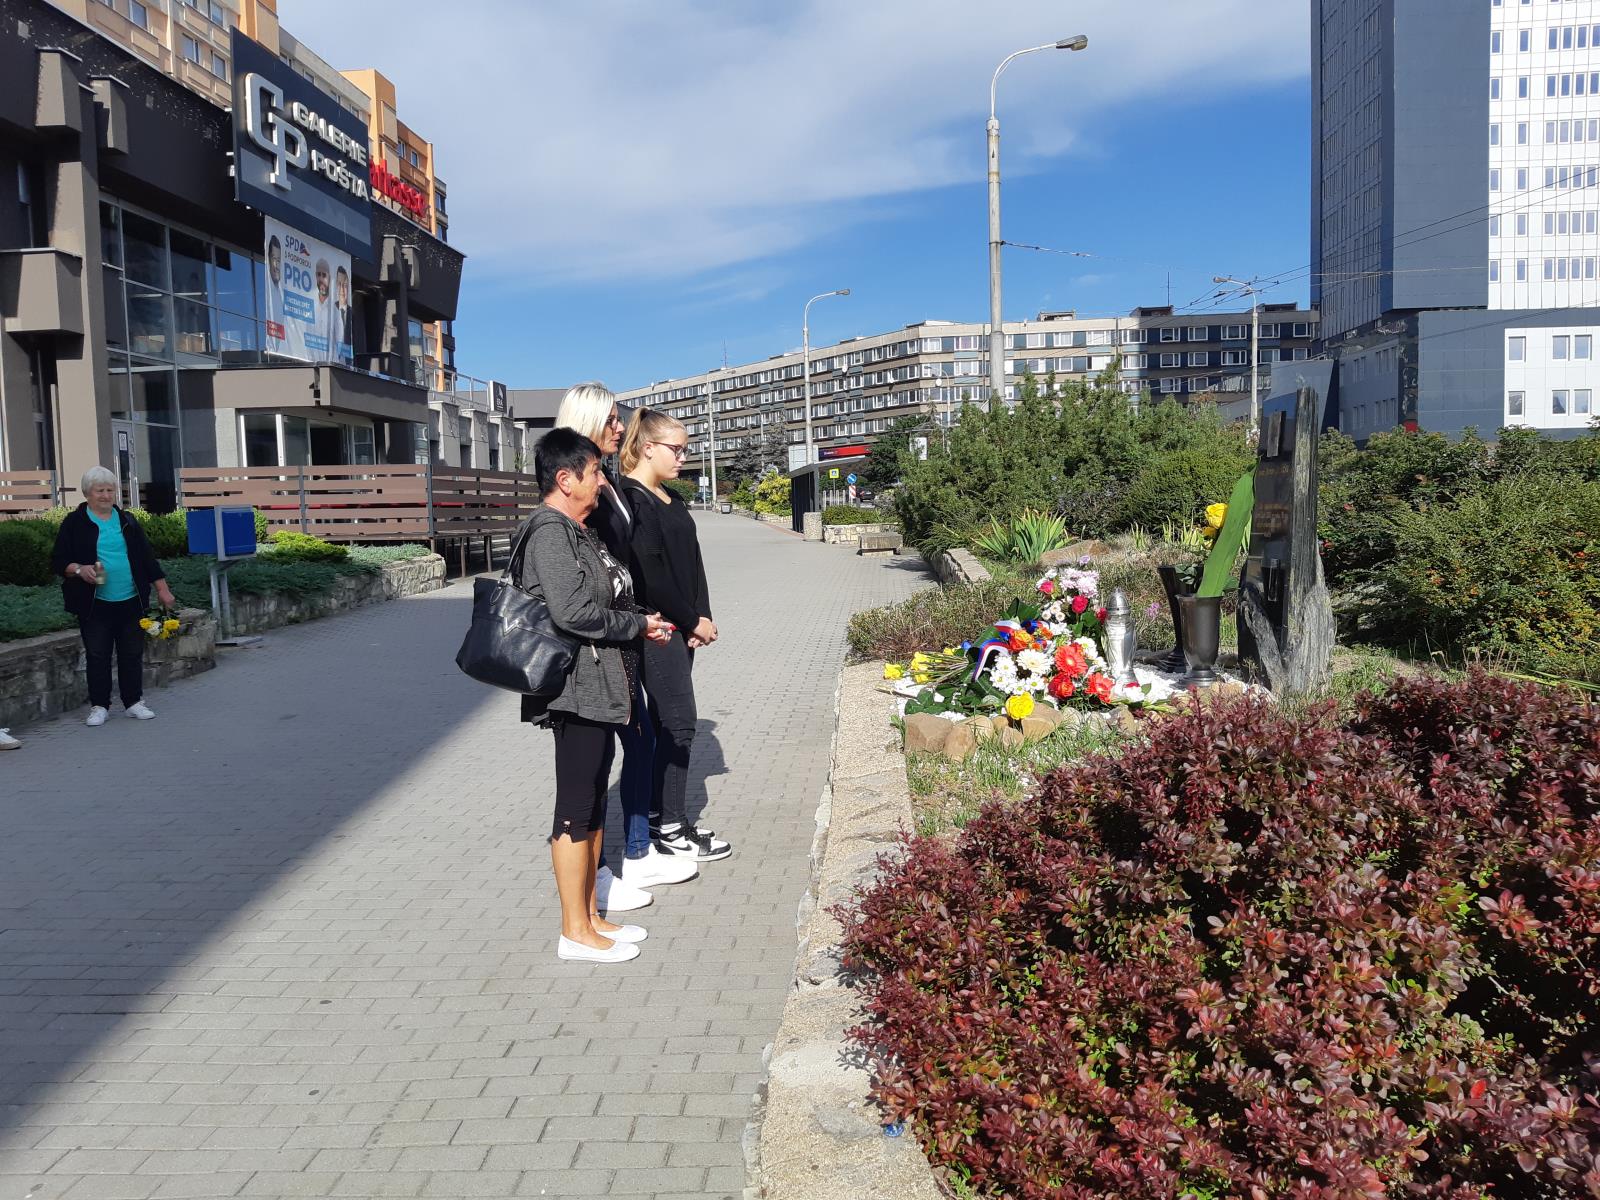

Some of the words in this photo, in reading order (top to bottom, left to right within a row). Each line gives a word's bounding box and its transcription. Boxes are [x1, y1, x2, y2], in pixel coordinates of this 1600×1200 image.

[292, 101, 367, 167] GALERIE
[311, 149, 369, 202] POŠTA
[285, 235, 300, 252] SPD
[284, 262, 312, 293] PRO
